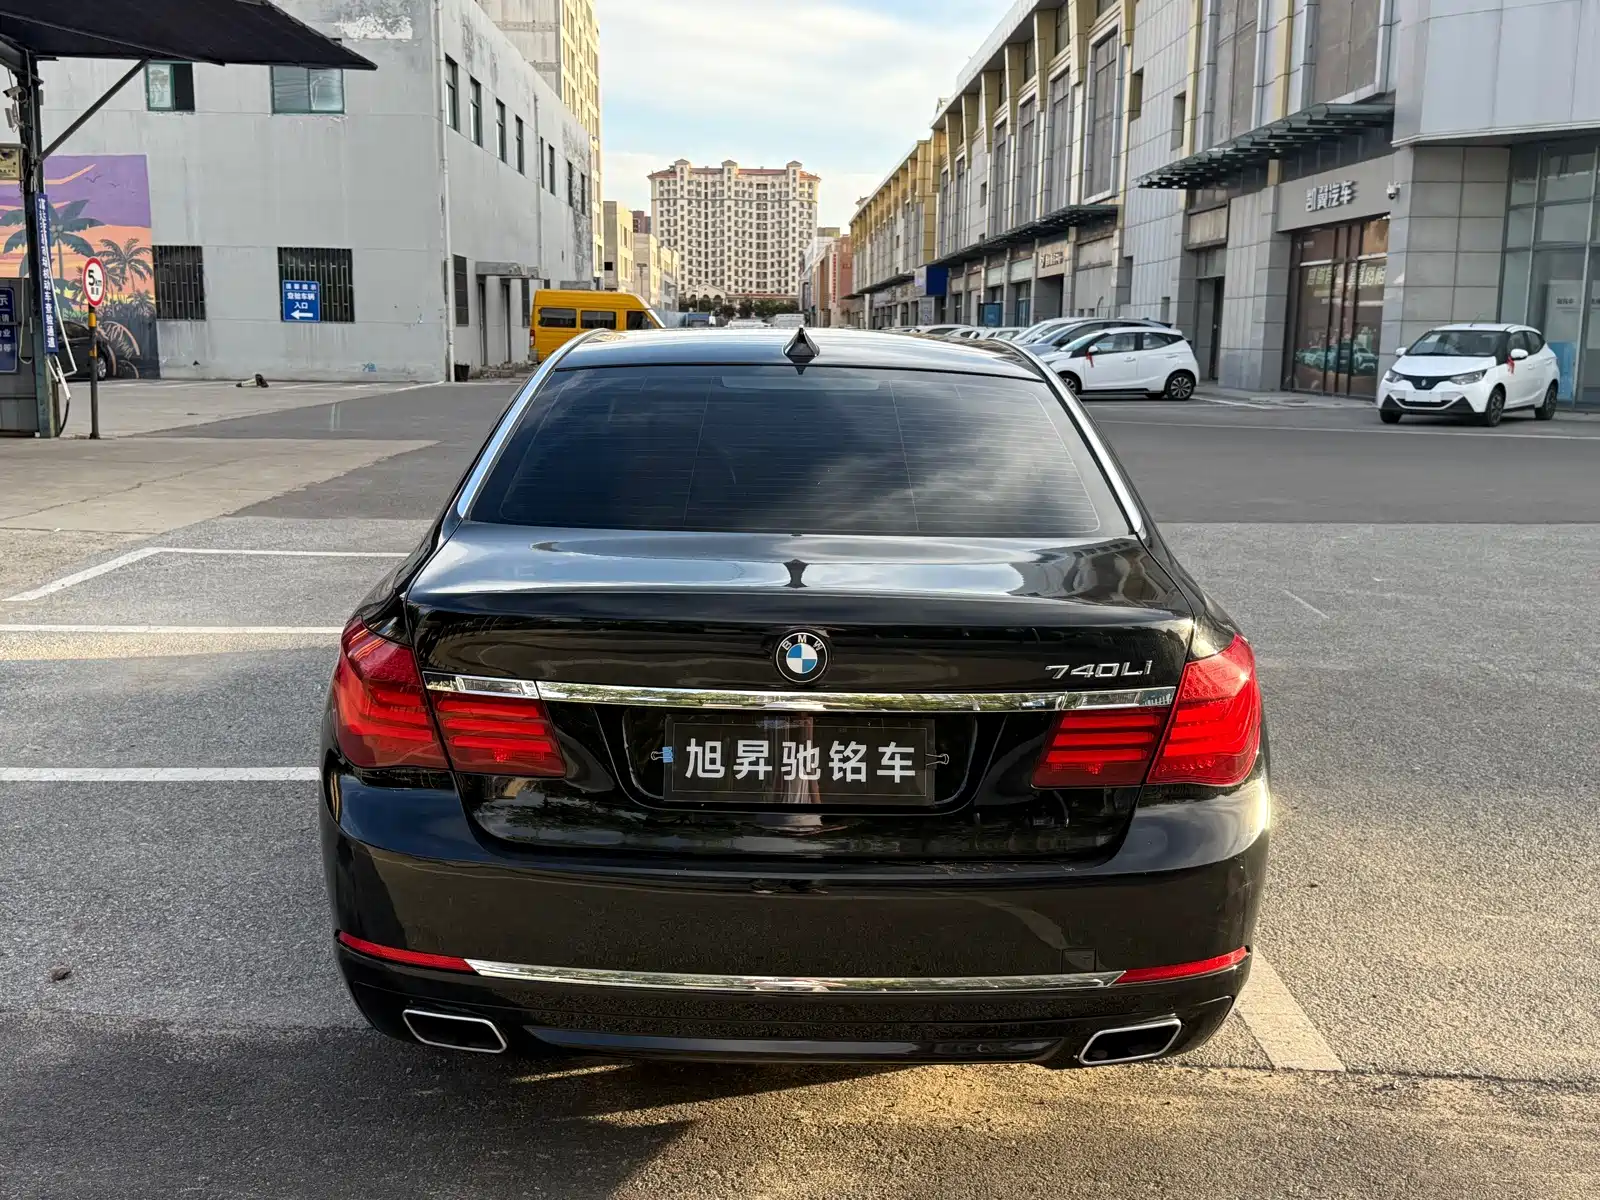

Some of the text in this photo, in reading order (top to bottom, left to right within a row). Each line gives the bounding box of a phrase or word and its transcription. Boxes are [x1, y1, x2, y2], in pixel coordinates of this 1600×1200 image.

[1305, 180, 1353, 212] 凯翼汽车
[781, 634, 824, 651] BMW
[1045, 659, 1153, 680] 740Li
[685, 738, 916, 784] 旭昇驰铭车
